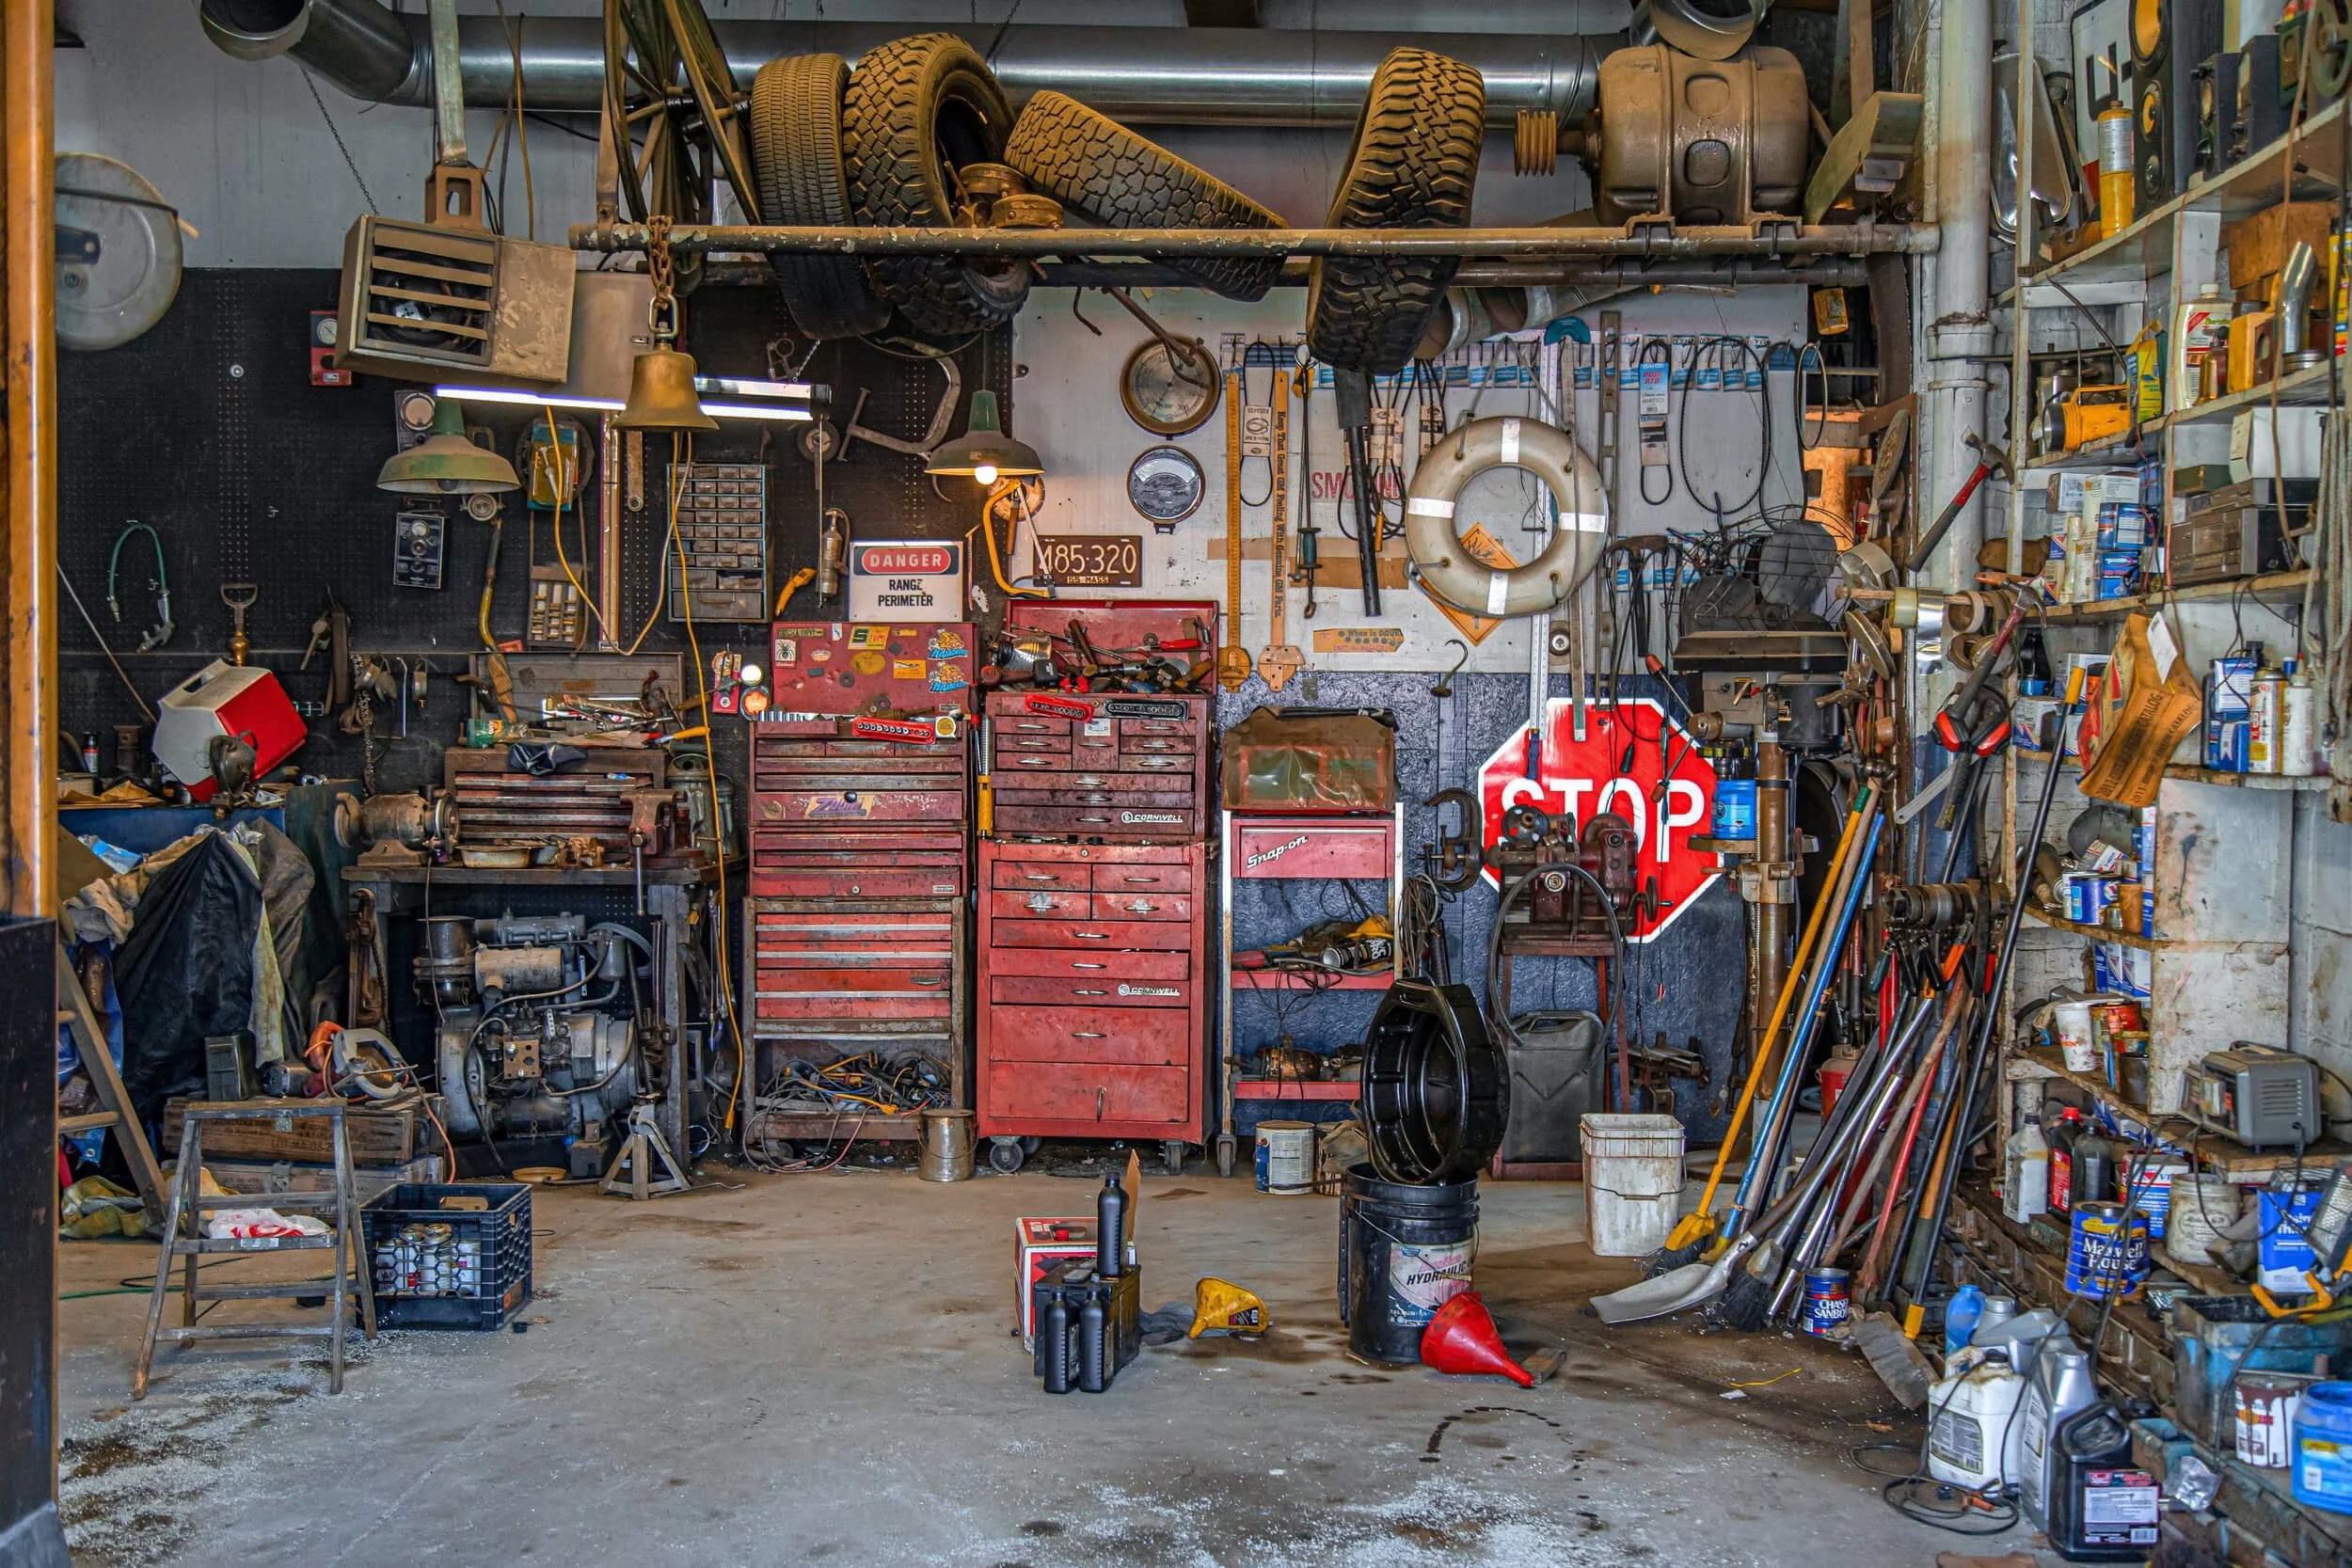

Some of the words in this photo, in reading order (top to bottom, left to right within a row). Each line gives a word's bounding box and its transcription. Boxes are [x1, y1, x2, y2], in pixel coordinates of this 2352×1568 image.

[1277, 411, 1287, 431] Keep
[1277, 433, 1286, 451] That
[1275, 524, 1285, 543] With
[869, 553, 942, 568] DANGER
[889, 578, 923, 592] RANGE
[878, 594, 933, 607] PERIMETER
[1247, 835, 1308, 869] Snap-on
